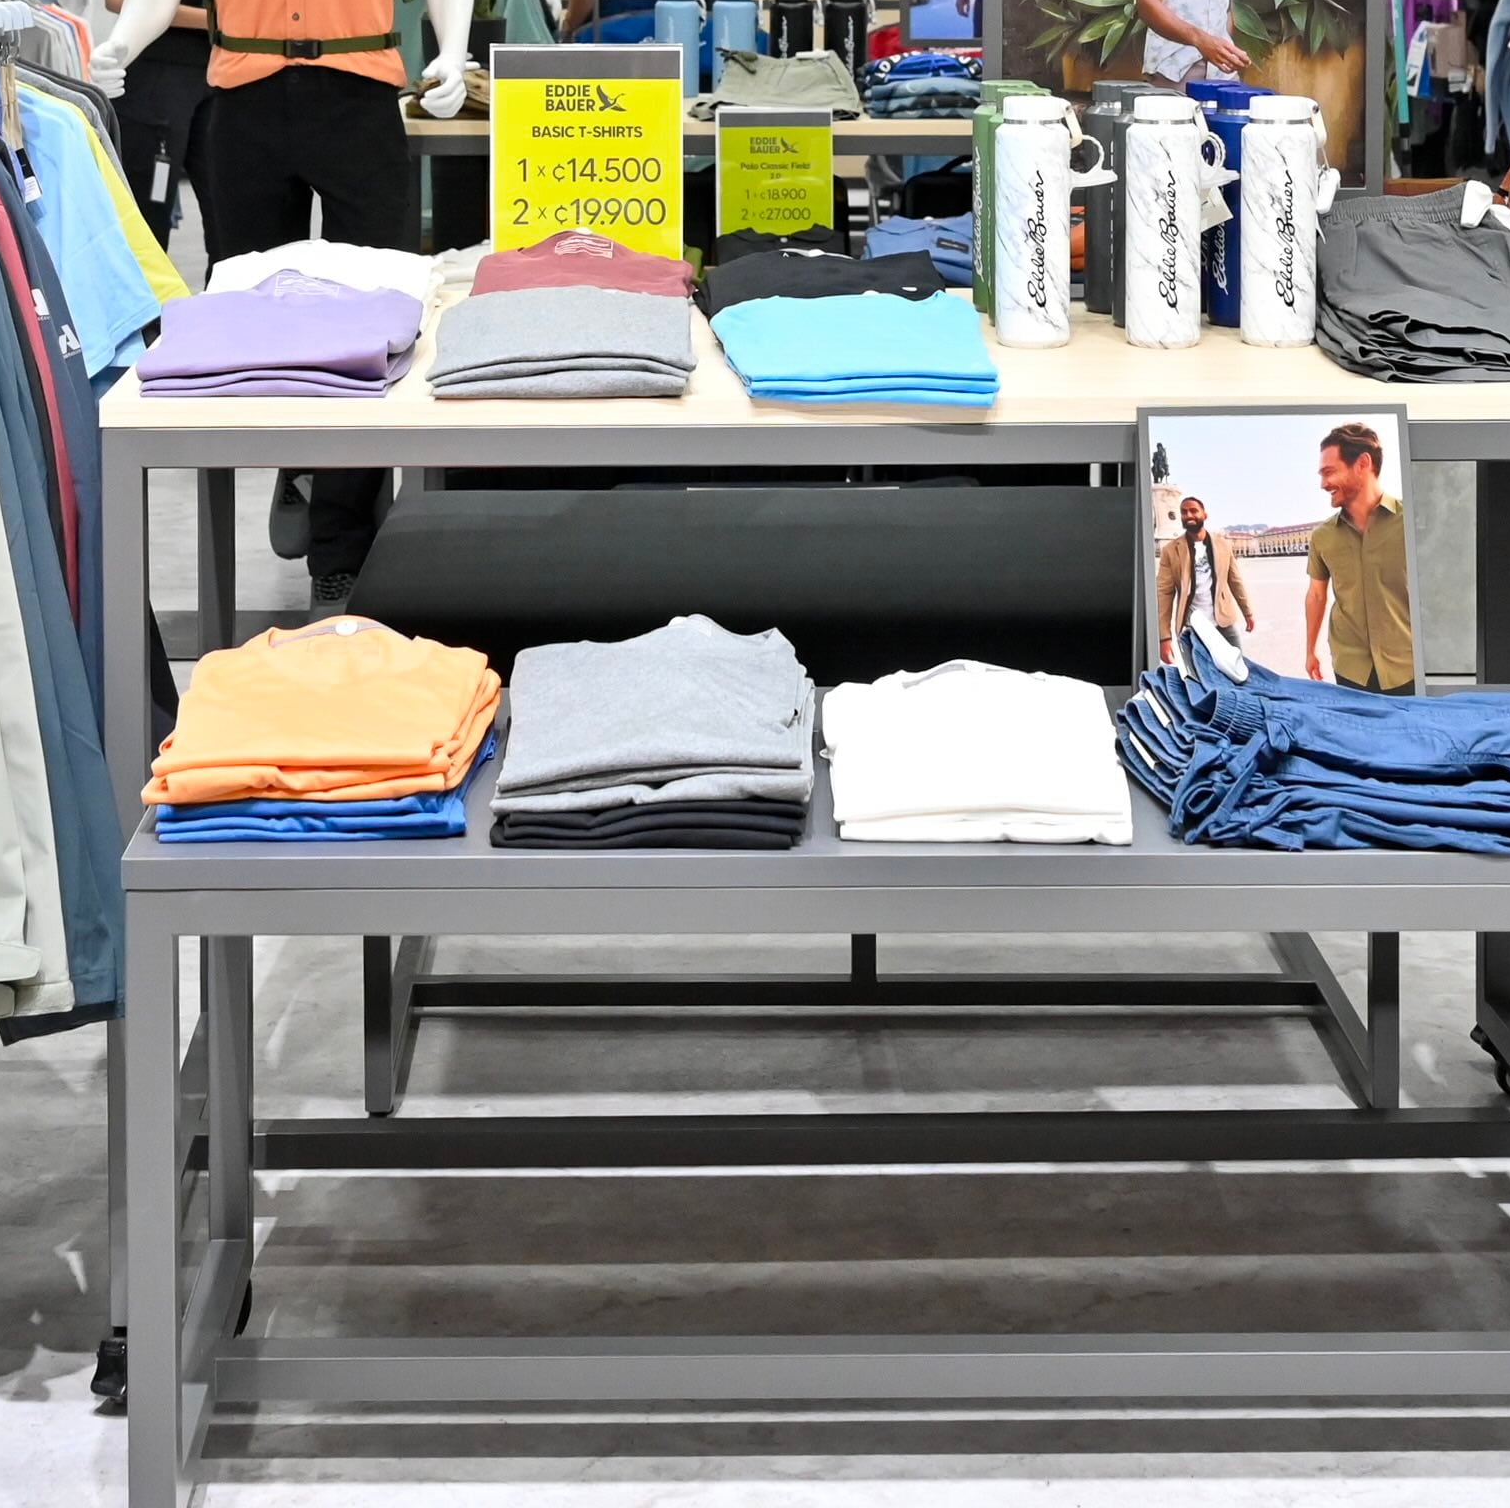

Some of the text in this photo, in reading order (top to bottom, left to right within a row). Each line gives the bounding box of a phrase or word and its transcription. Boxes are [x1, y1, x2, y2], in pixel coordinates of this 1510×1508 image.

[546, 84, 591, 97] EDDIE
[546, 99, 595, 112] BAUER
[532, 126, 643, 138] BASIC T-SHIRTS
[750, 137, 778, 145] EDDIE
[750, 145, 781, 154] BAUER
[517, 158, 528, 183] 1
[740, 162, 759, 170] Polo
[512, 198, 529, 225] 2
[1027, 170, 1048, 314] Eddie Bauer
[1159, 170, 1180, 314] Eddie Bauer
[1276, 170, 1297, 314] Eddie Bauer
[1212, 229, 1229, 296] Eddie
